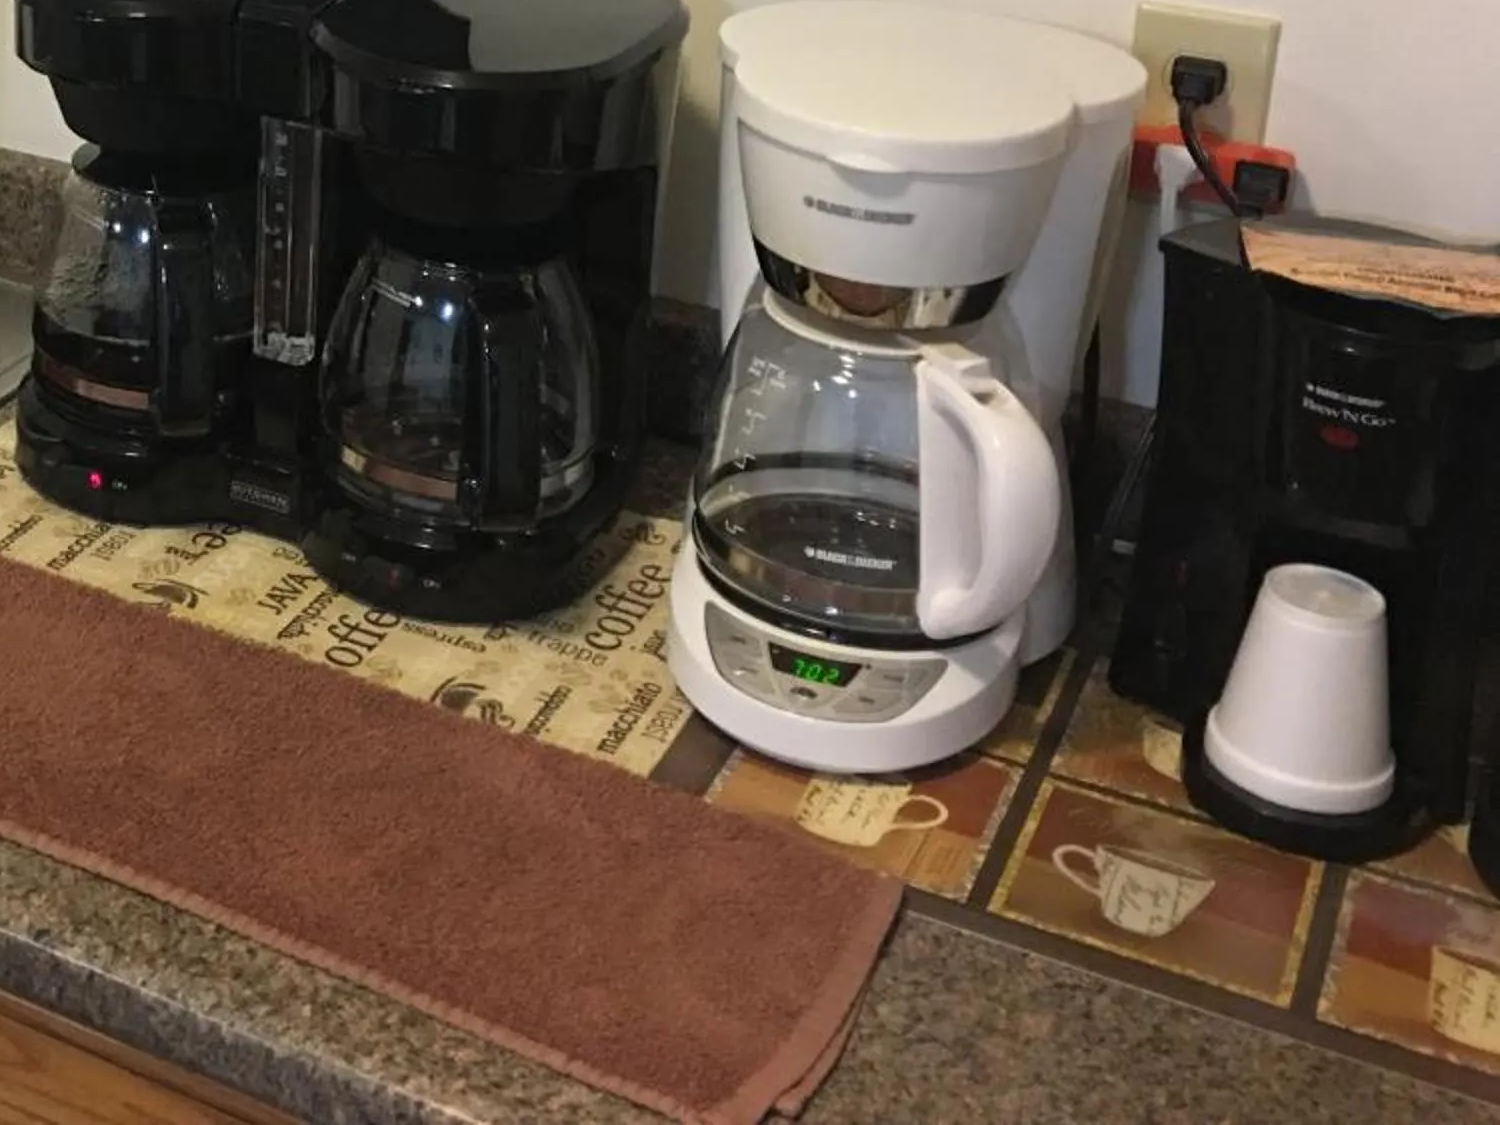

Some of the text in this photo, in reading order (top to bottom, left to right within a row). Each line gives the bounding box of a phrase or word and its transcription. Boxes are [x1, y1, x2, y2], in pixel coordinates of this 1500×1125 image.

[47, 522, 112, 571] macchia
[257, 572, 318, 616] JAVA
[585, 563, 671, 651] coffee
[325, 609, 401, 668] offe
[596, 681, 664, 756] macchiato
